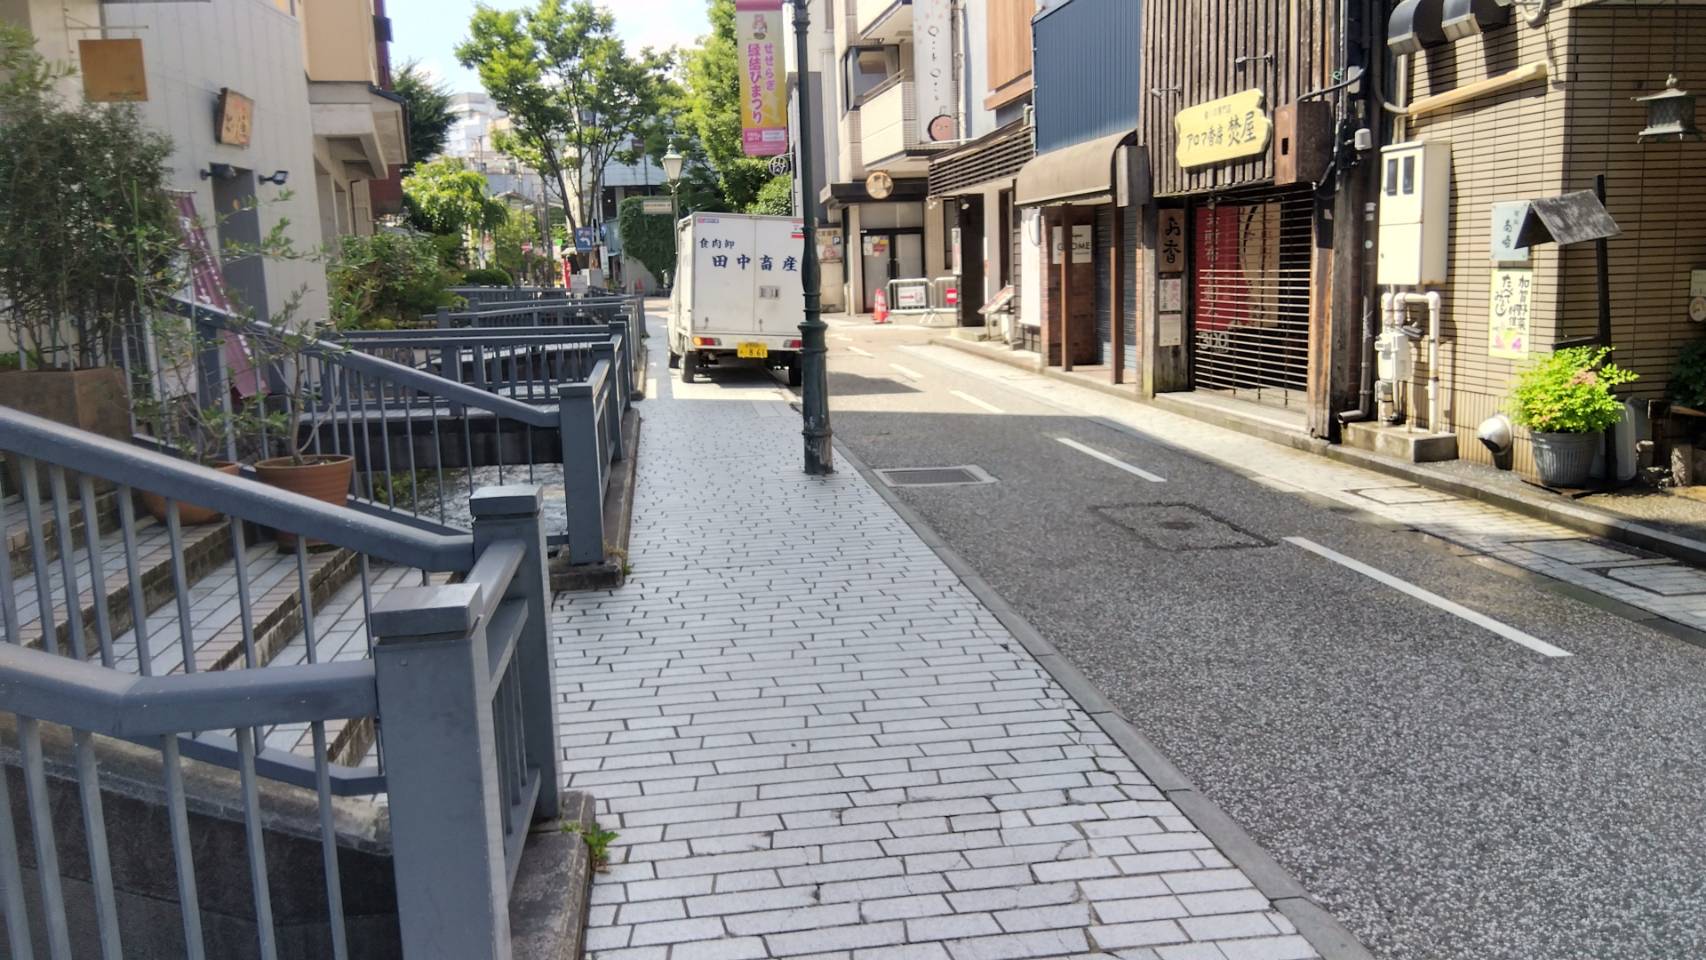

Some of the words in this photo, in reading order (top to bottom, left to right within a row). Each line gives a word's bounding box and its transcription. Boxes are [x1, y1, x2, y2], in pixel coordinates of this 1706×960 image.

[747, 43, 763, 124] 縁結びまつり
[764, 42, 776, 92] せせらぎ
[699, 237, 736, 250] 食肉卸
[712, 254, 798, 272] 田中畜産
[1162, 216, 1182, 264] お香
